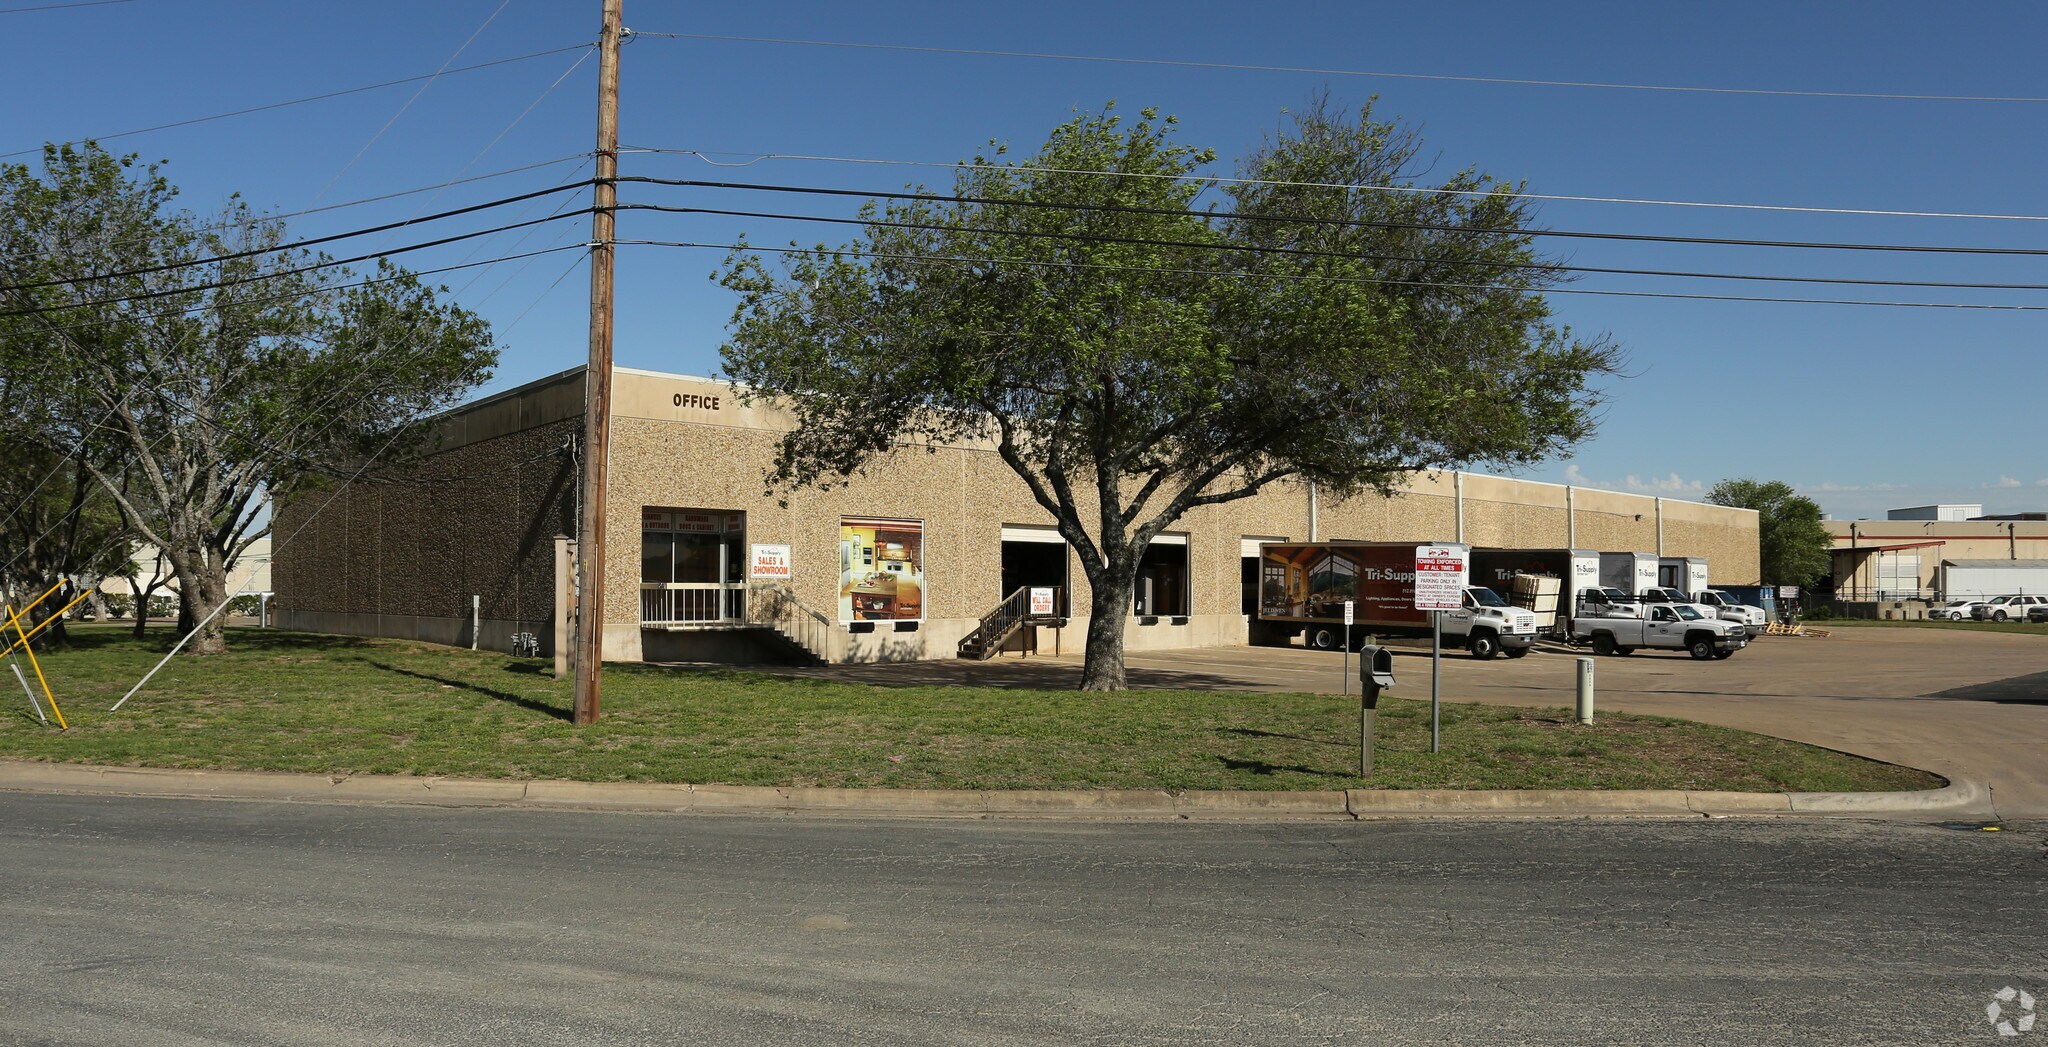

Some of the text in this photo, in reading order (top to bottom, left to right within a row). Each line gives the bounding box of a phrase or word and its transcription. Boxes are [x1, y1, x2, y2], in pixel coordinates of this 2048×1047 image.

[673, 393, 720, 410] OFFICE
[758, 556, 783, 565] SALES &
[753, 565, 788, 575] SHOWROOM
[1576, 564, 1597, 574] Tri-Supply
[1638, 568, 1657, 578] Tri-Supply
[1365, 567, 1416, 583] Tri-Supp
[1032, 596, 1052, 604] WILL CALL
[1034, 604, 1050, 612] ORDERS
